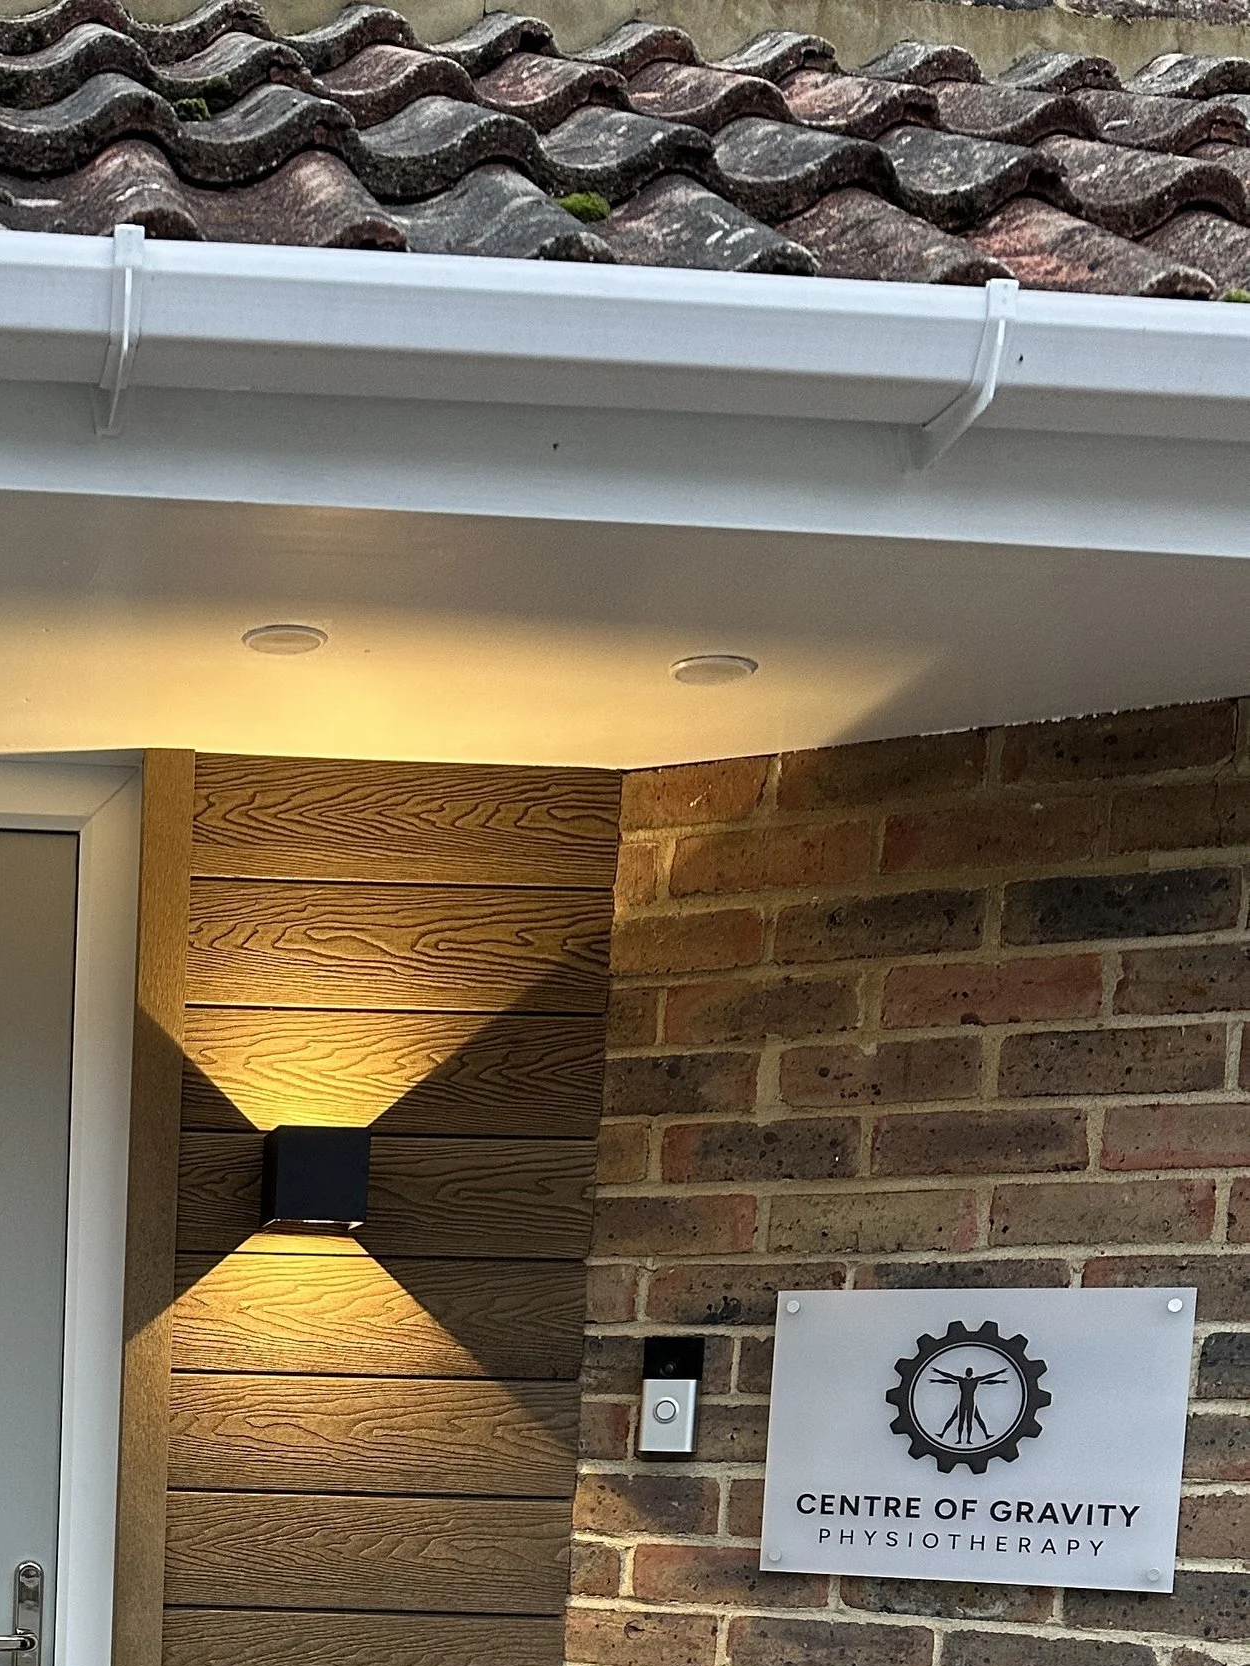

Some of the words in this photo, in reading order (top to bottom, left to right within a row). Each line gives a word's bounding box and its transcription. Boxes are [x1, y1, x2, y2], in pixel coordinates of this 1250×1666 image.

[796, 1493, 922, 1519] CENTRE
[934, 1497, 978, 1521] OF
[989, 1500, 1141, 1527] GRAVITY
[818, 1528, 1105, 1557] PHYSIOTHERAPY
